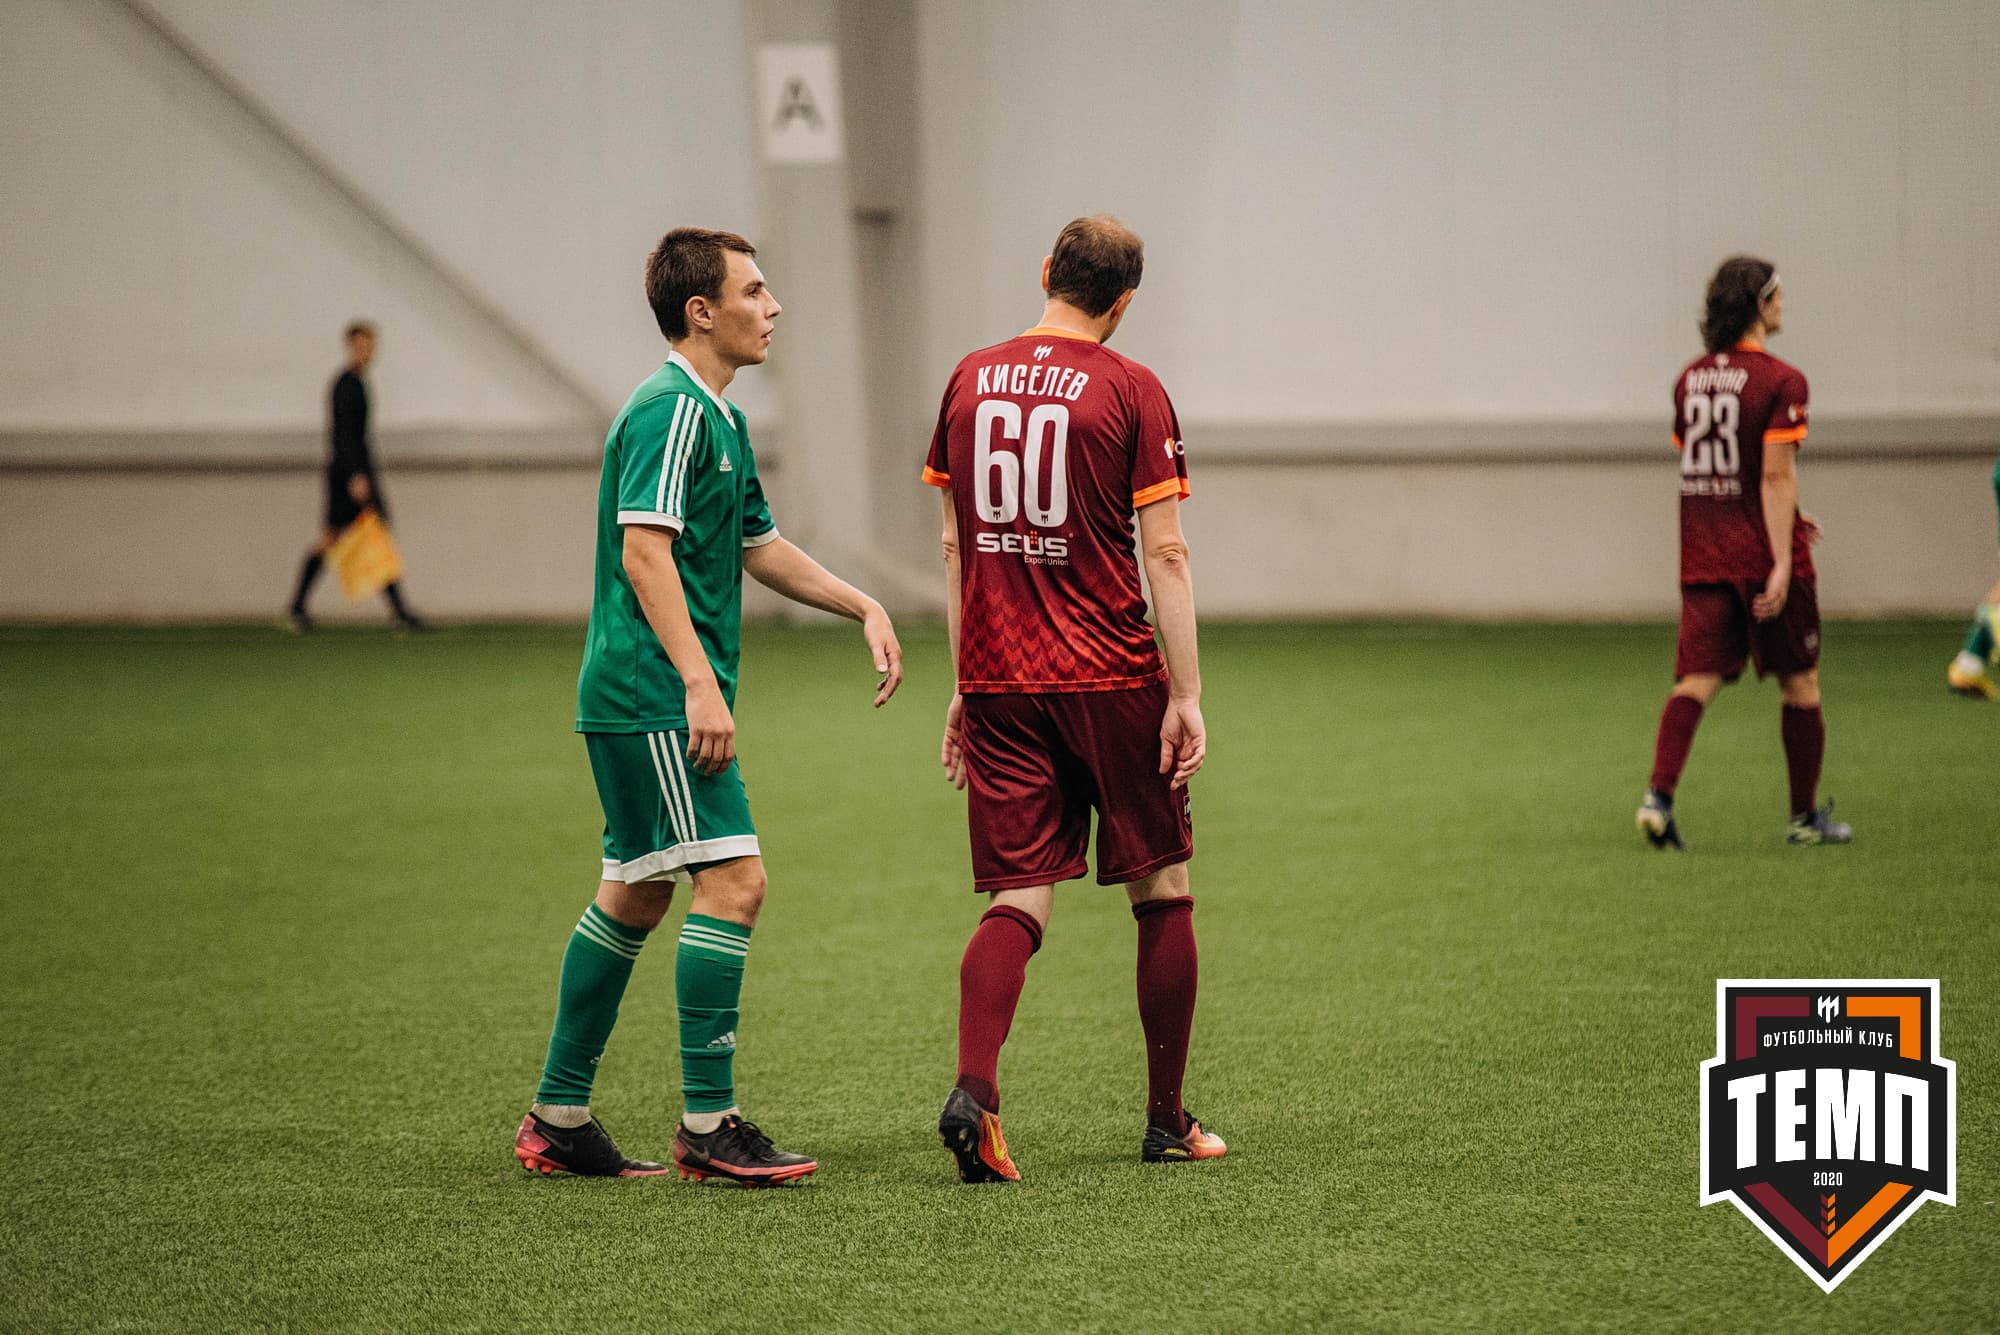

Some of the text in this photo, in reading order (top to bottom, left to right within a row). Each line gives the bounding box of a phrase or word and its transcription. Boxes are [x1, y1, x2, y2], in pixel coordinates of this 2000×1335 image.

[976, 363, 1089, 401] КИСЕЛЕВ
[974, 399, 1070, 528] 60
[1681, 392, 1741, 476] 23
[1047, 557, 1069, 566] Union
